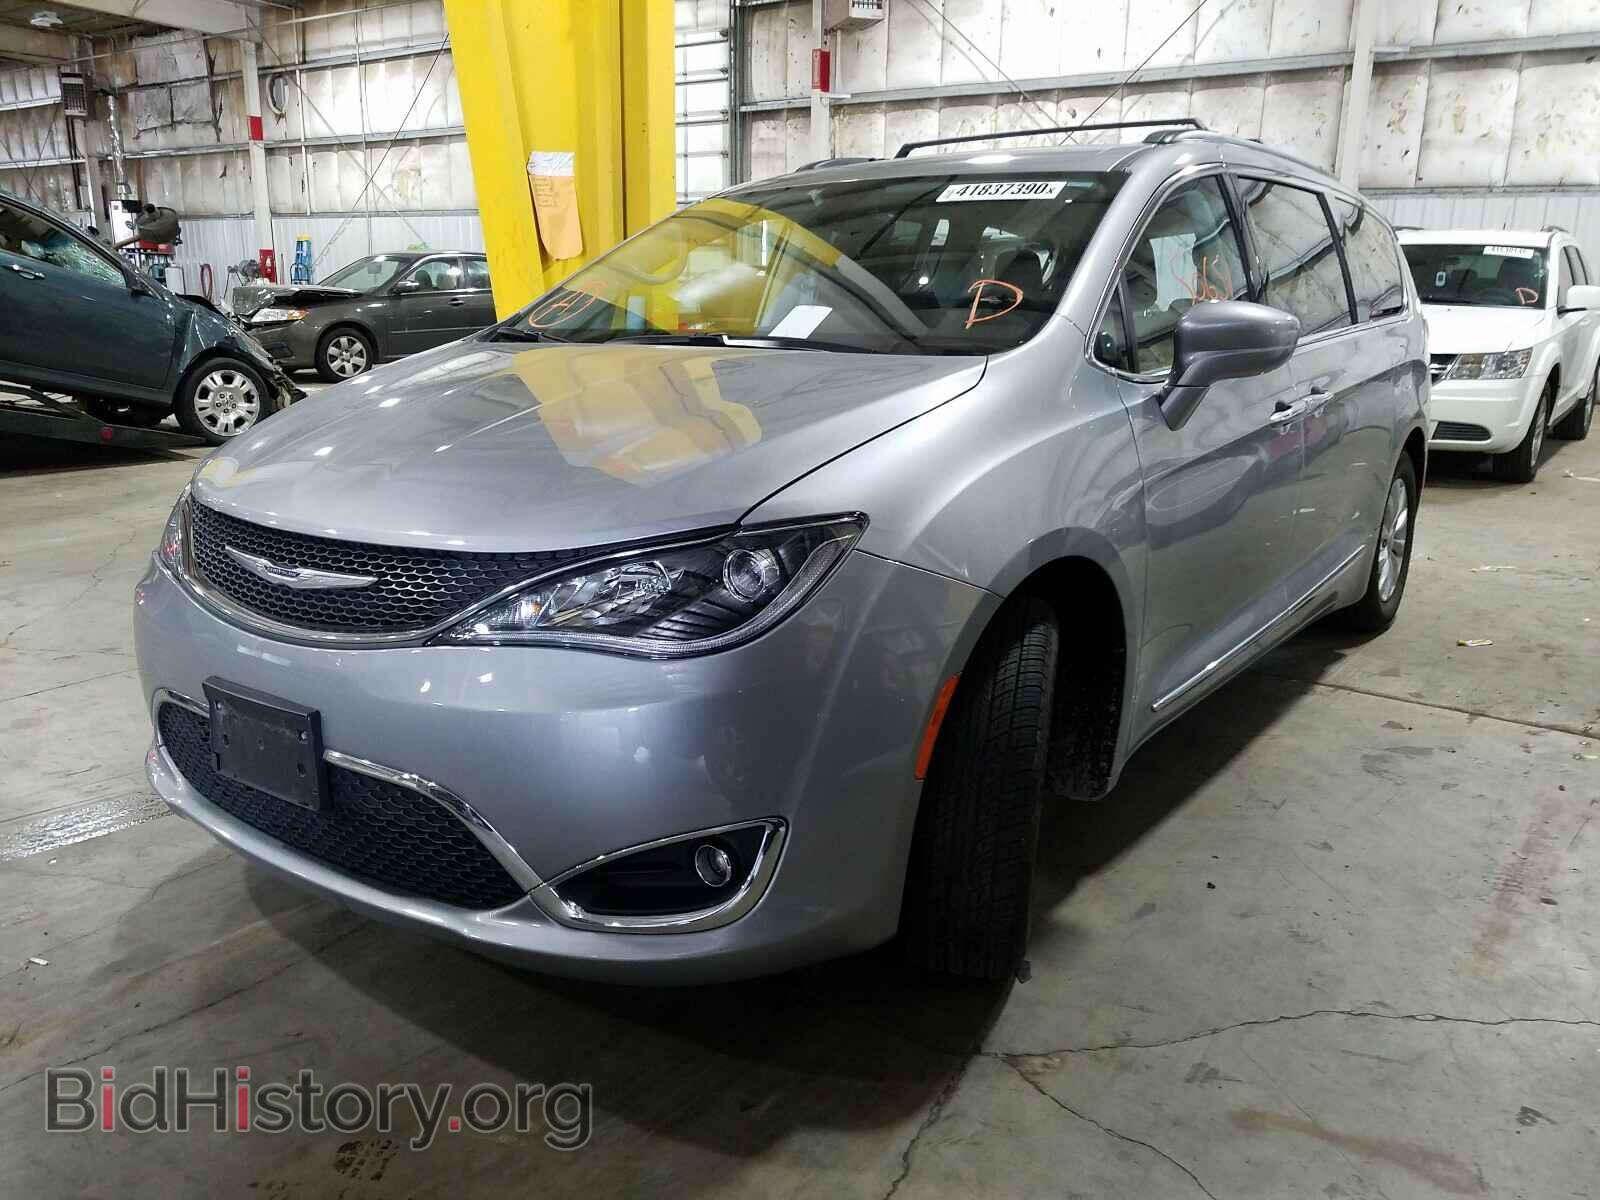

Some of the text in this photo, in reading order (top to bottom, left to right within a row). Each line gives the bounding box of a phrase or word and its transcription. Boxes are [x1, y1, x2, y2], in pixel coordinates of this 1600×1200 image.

[956, 182, 1049, 197] 41837390
[1515, 287, 1539, 304] D
[965, 280, 1024, 330] D
